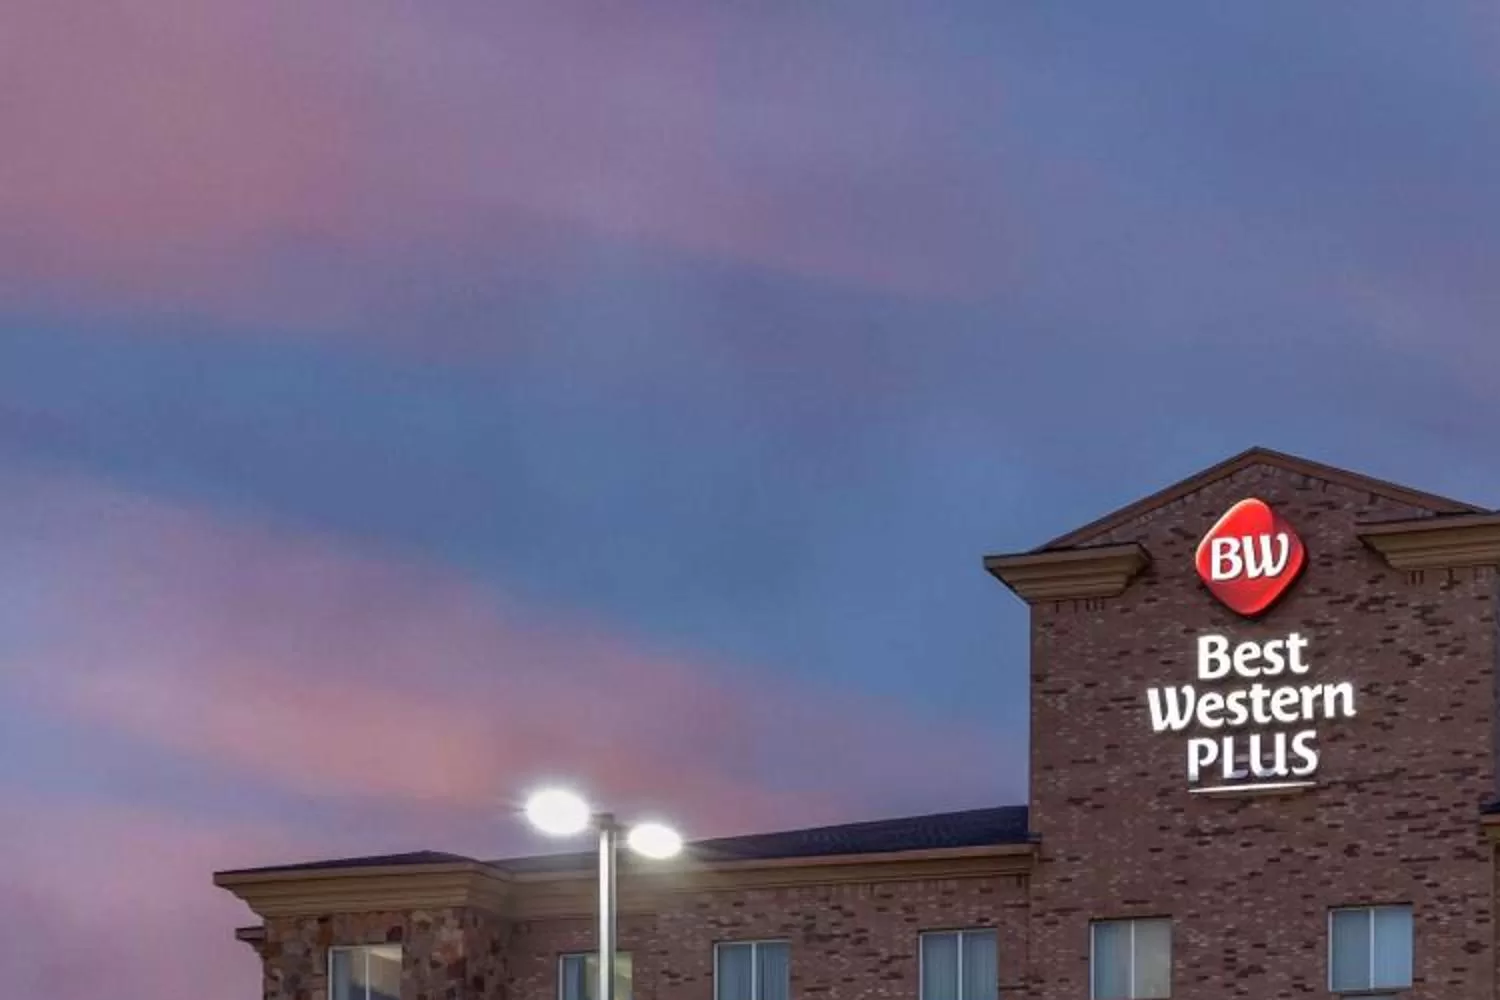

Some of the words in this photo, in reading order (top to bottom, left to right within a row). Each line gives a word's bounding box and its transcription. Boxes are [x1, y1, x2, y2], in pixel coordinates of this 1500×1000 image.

[1210, 533, 1290, 582] BW
[1197, 632, 1310, 680] Best
[1146, 681, 1358, 733] Western
[1187, 730, 1319, 782] PLUS
